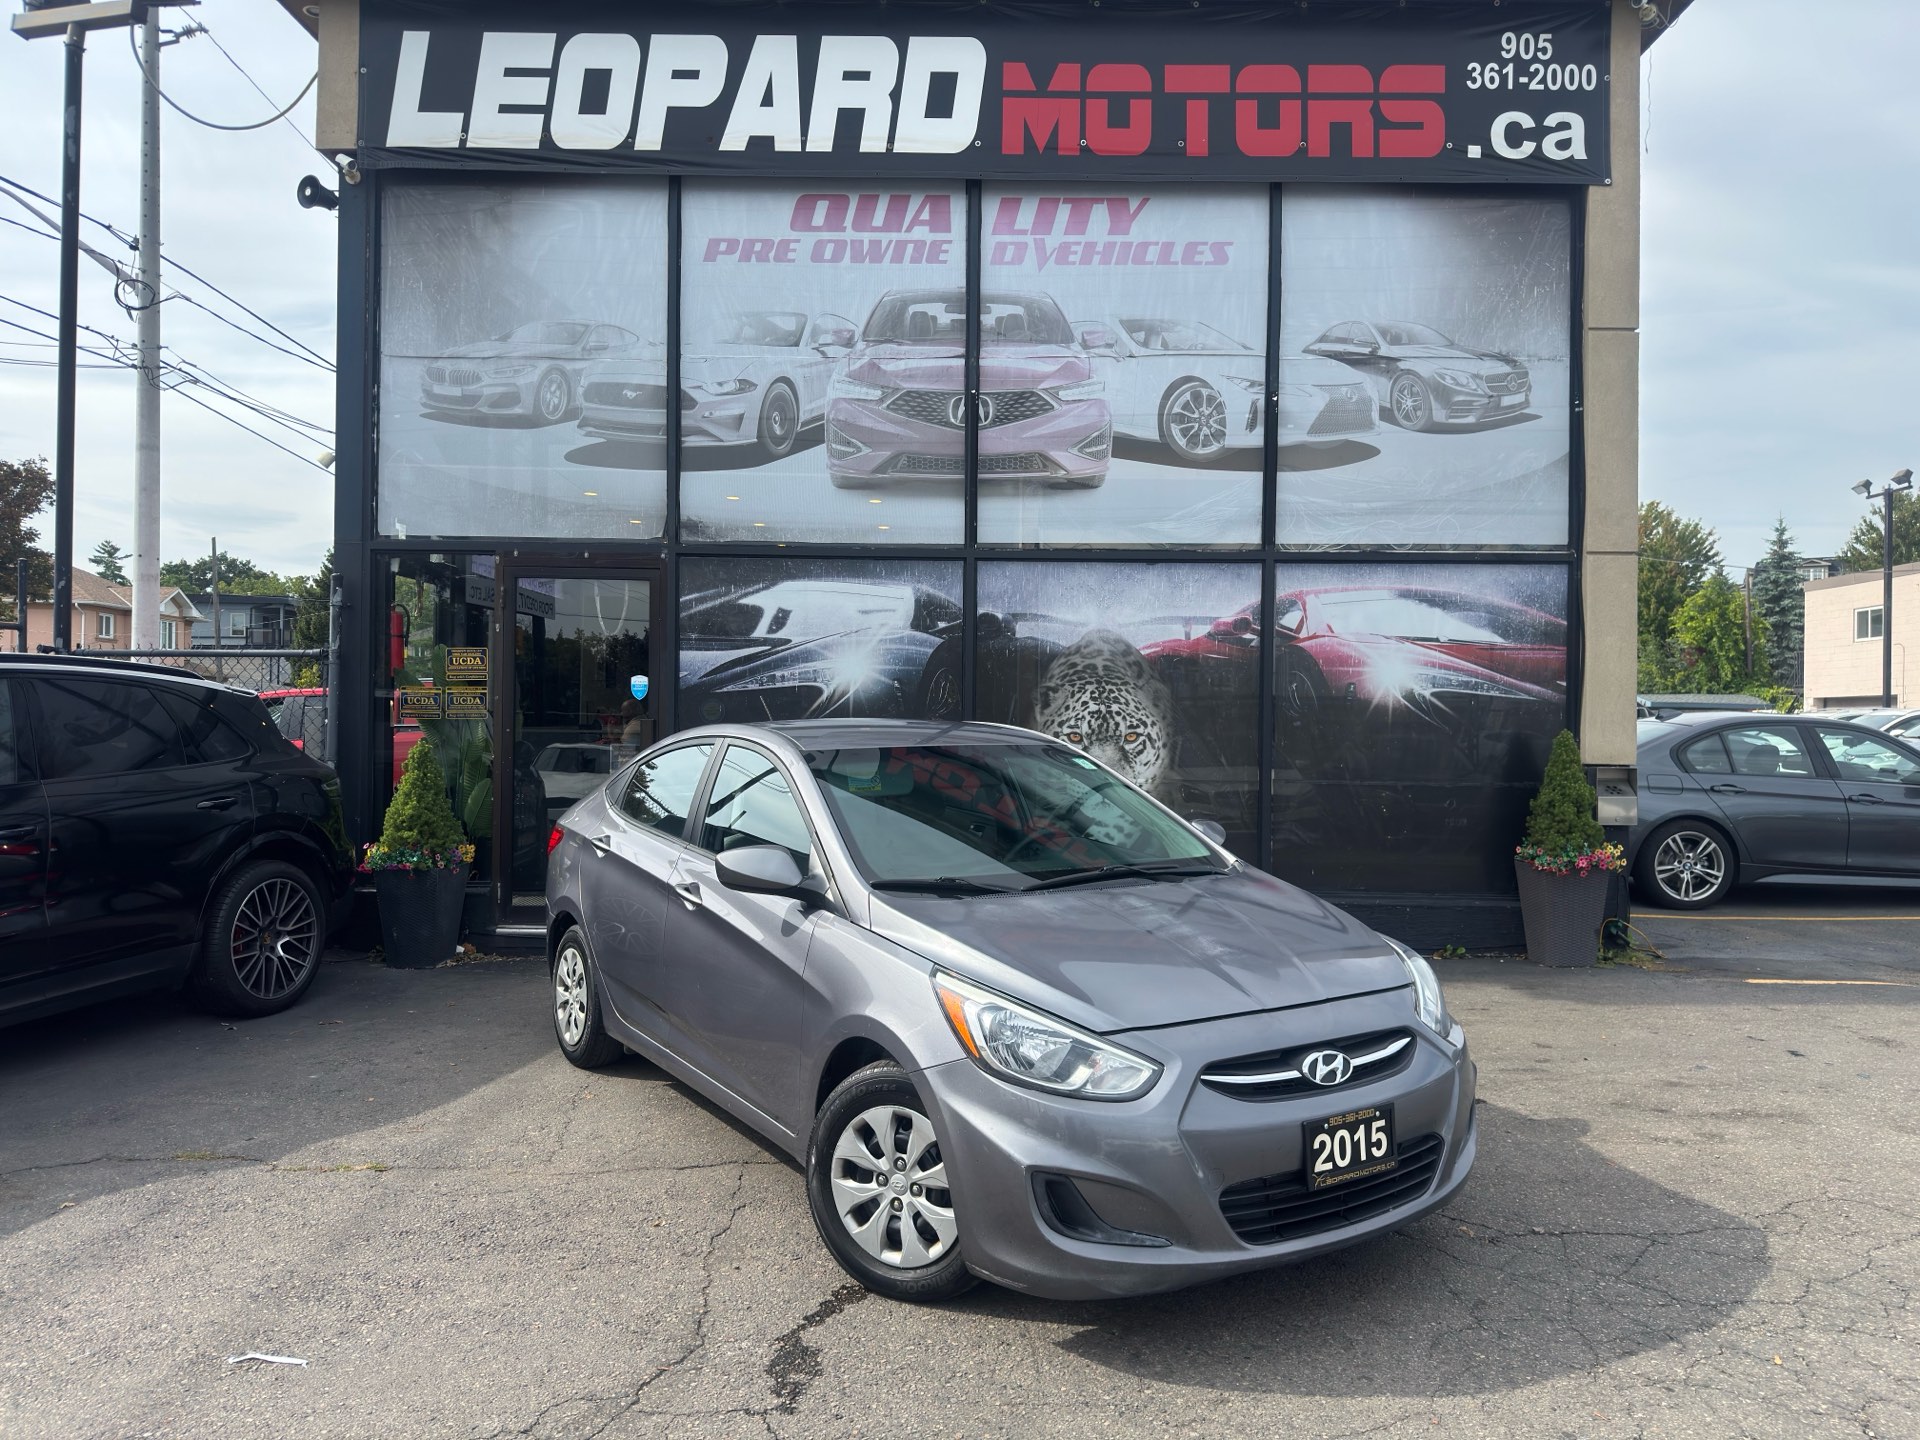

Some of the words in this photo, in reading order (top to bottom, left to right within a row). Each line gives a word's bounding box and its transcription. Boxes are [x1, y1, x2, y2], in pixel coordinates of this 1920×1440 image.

[1501, 32, 1553, 60] 905
[1466, 62, 1597, 91] 361-2000
[386, 31, 987, 153] LEOPARD
[1002, 62, 1446, 158] MOTORS
[1467, 111, 1588, 160] .ca
[703, 238, 801, 263] PRE
[452, 657, 482, 665] UCDA
[407, 696, 435, 705] UCDA
[453, 697, 481, 705] UCDA
[1328, 1108, 1375, 1127] 905-361-2000
[1313, 1119, 1388, 1173] 2015
